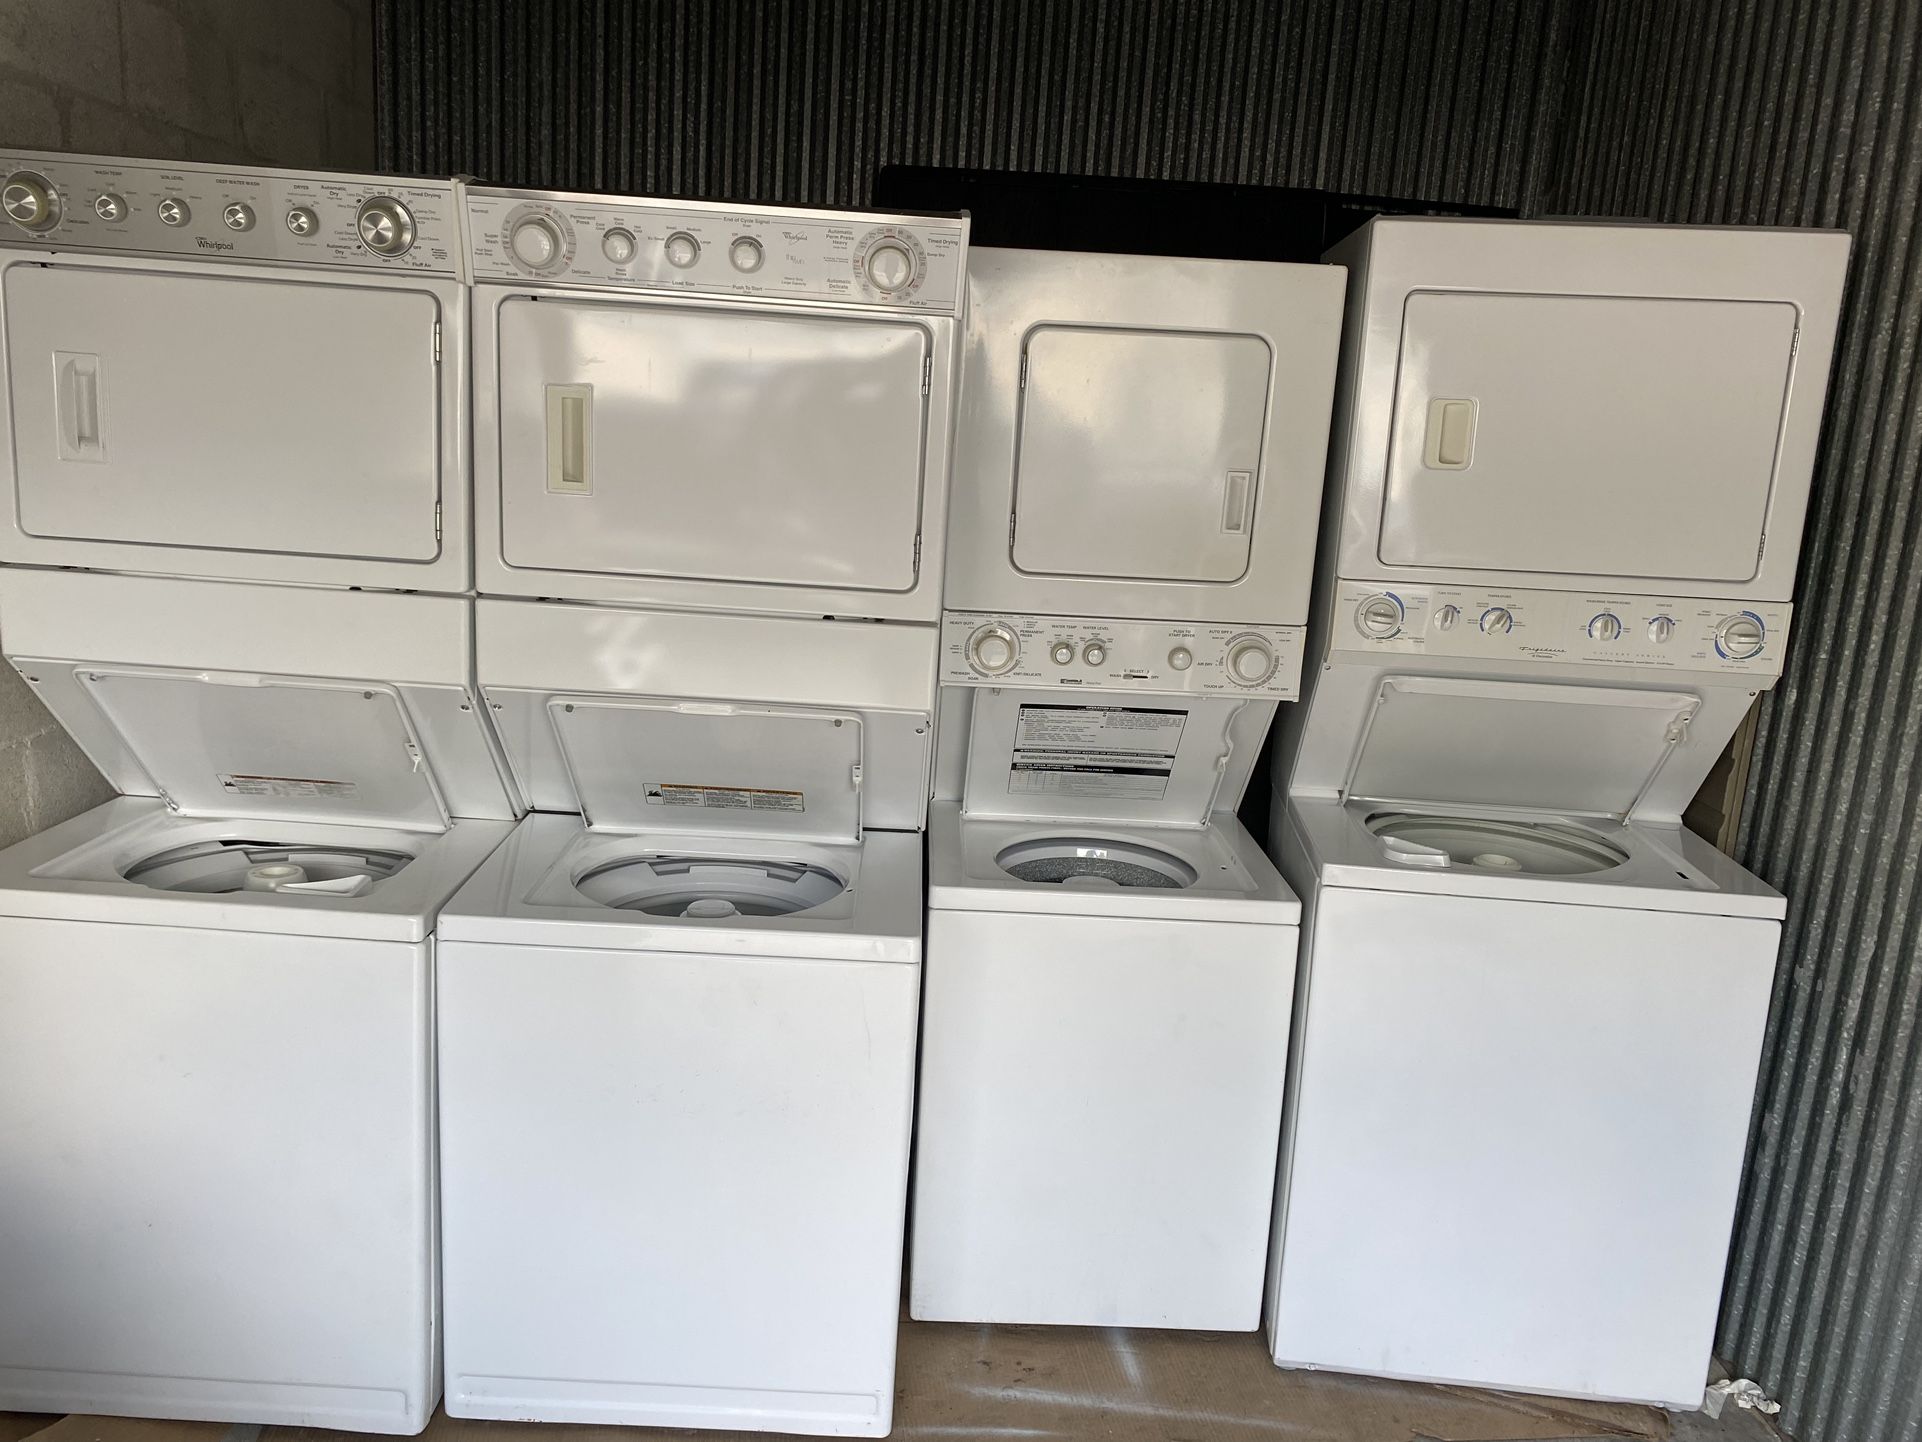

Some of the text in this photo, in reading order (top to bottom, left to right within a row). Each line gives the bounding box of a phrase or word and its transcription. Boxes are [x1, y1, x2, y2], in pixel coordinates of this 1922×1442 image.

[424, 191, 442, 199] Drying
[196, 240, 234, 251] Whirlpool
[607, 275, 636, 283] Temperature
